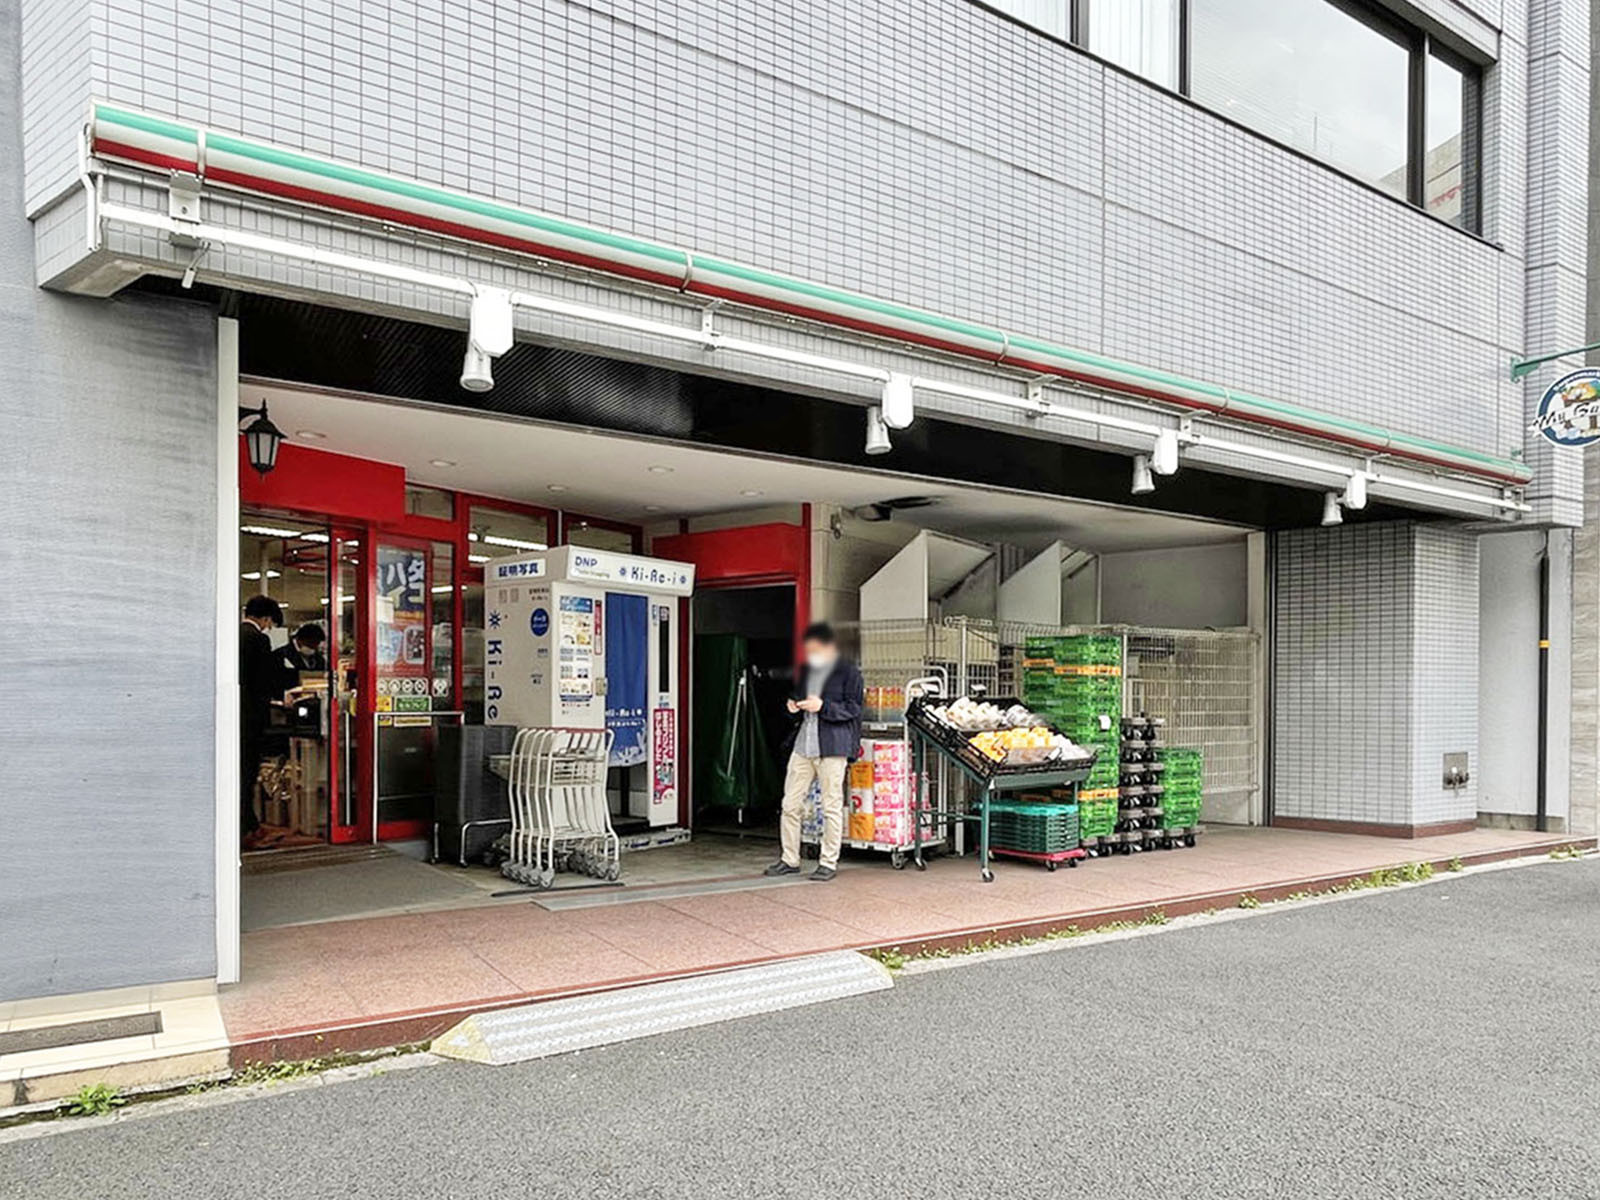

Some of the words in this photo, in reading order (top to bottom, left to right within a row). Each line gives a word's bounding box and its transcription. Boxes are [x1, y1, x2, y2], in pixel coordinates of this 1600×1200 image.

[575, 556, 598, 567] DNP
[498, 563, 539, 577] 証明写真
